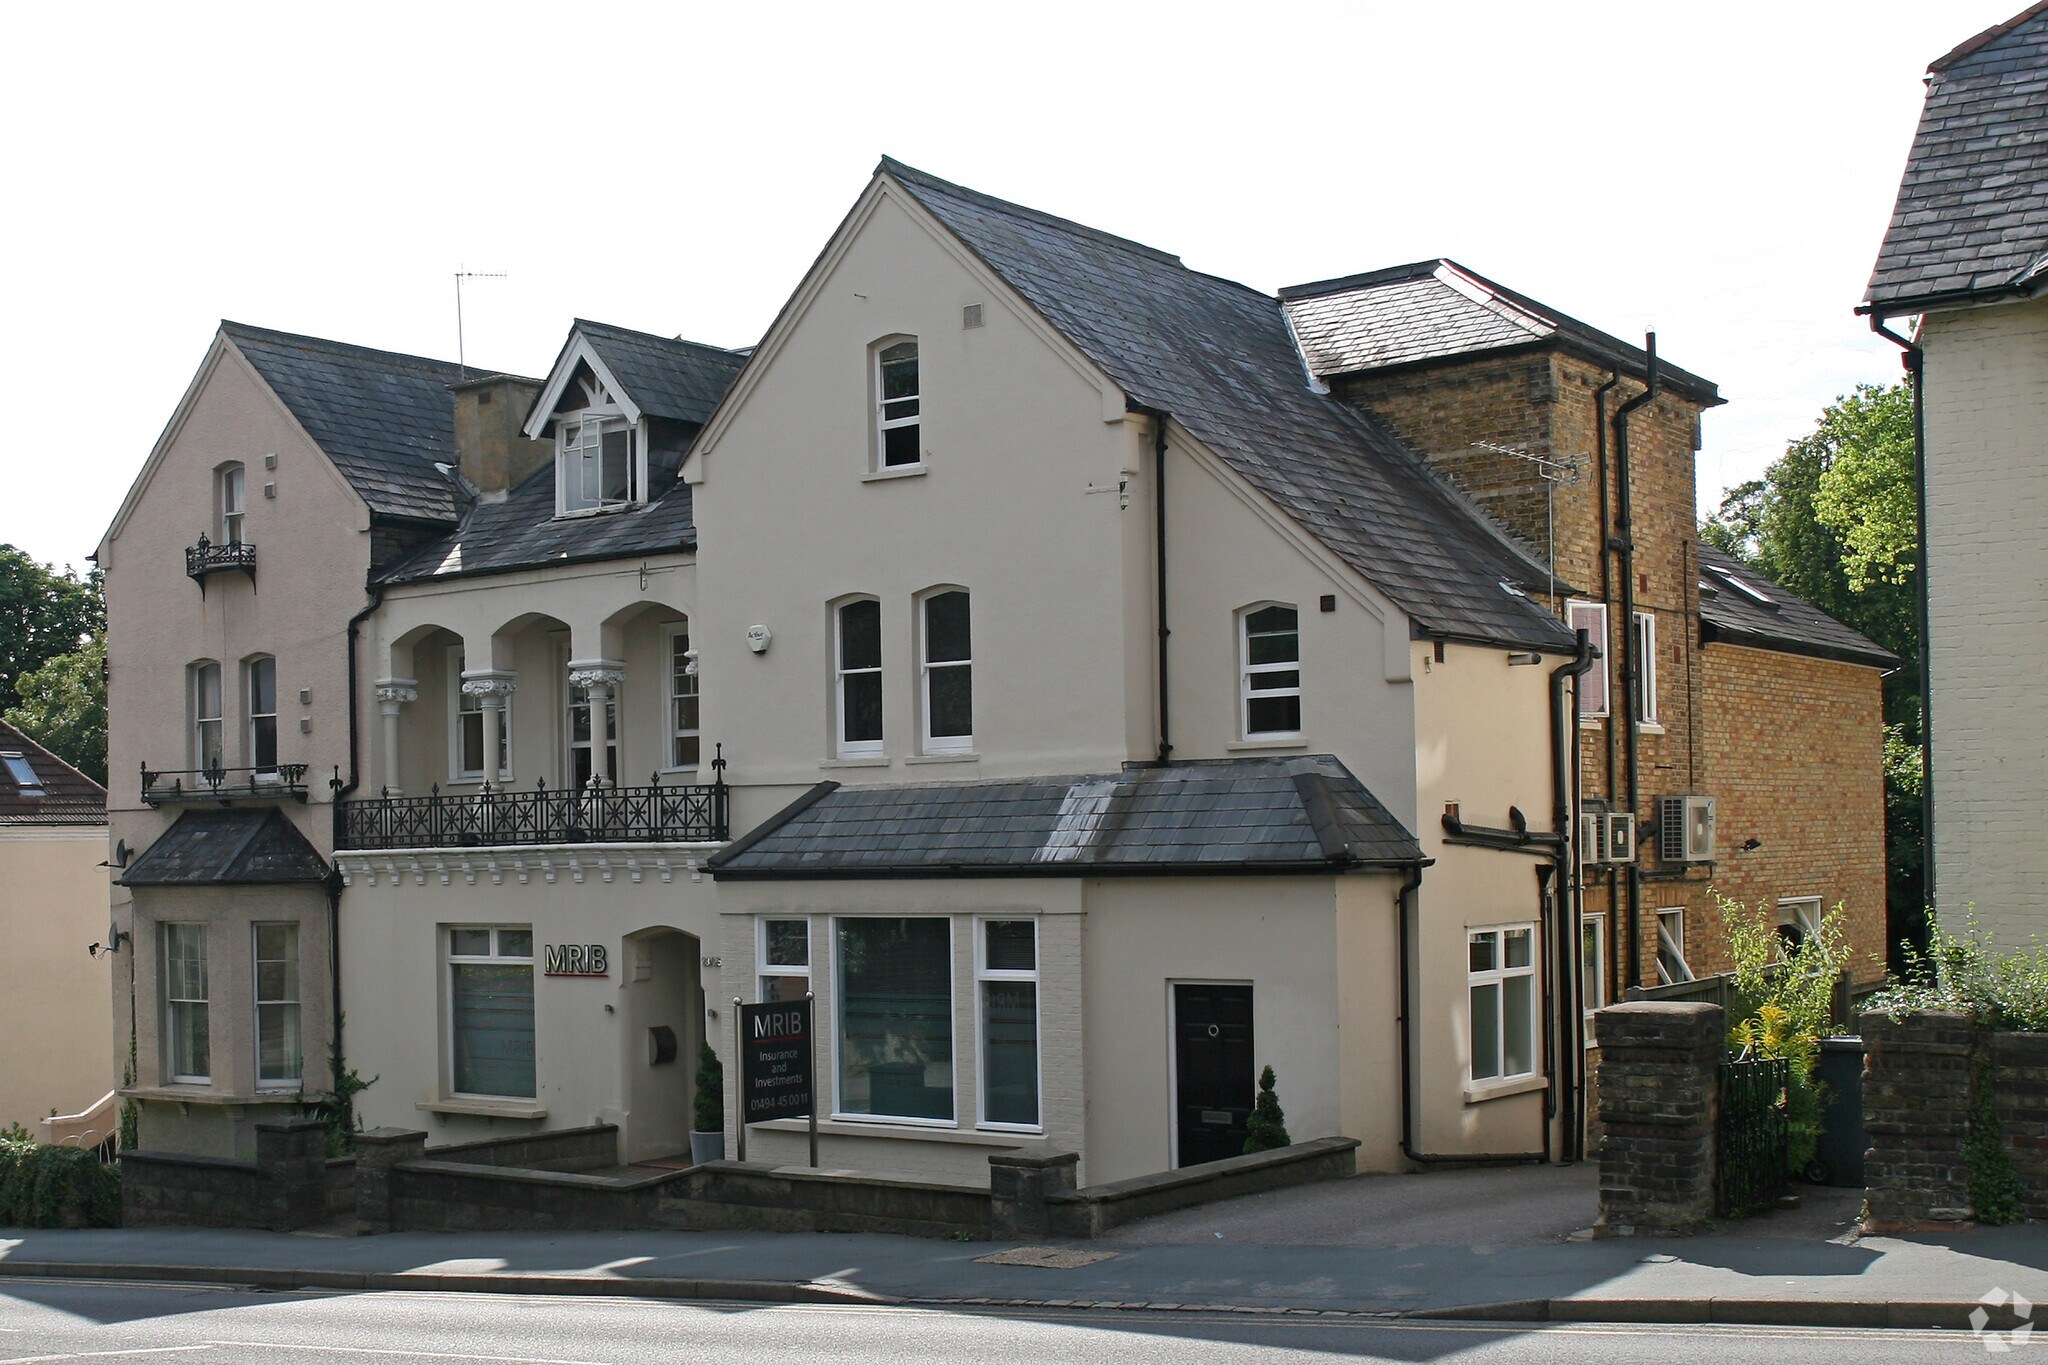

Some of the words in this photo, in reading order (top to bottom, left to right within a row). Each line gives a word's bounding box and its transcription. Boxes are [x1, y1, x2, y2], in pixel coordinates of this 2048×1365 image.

[544, 945, 607, 974] MRIB
[754, 1012, 802, 1038] MRIB
[759, 1049, 799, 1061] Insurance
[771, 1062, 787, 1074] and
[755, 1074, 803, 1088] Investments
[751, 1096, 776, 1111] 01494
